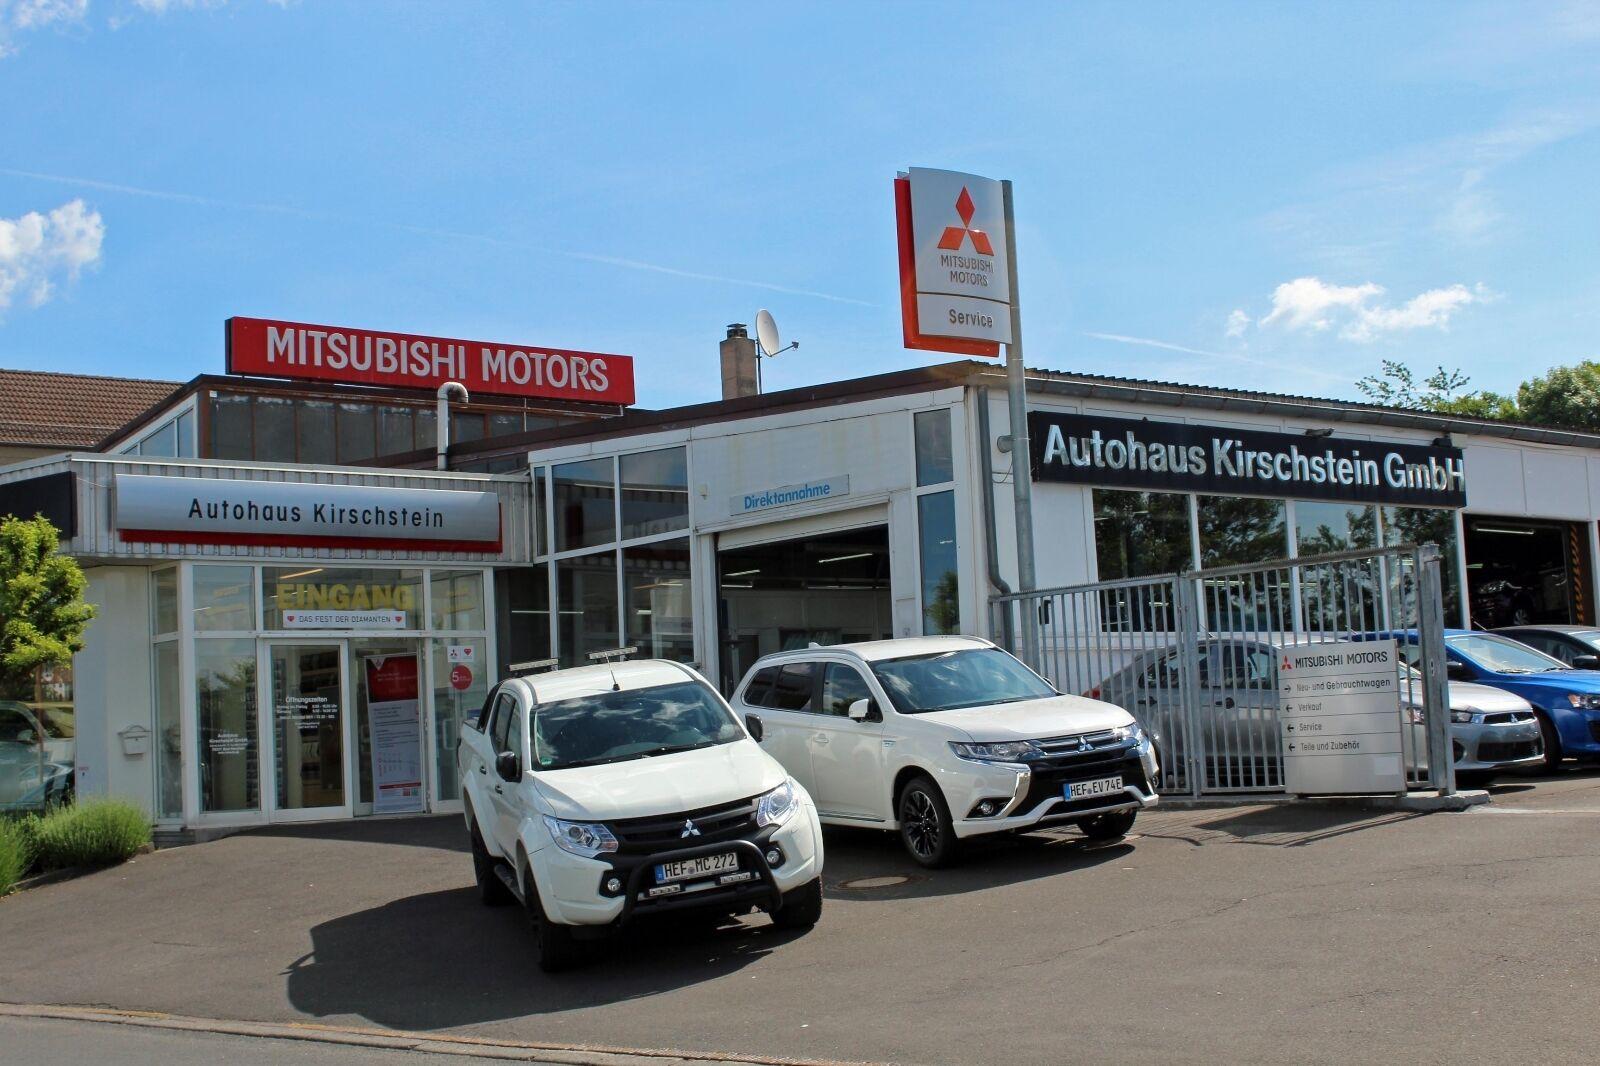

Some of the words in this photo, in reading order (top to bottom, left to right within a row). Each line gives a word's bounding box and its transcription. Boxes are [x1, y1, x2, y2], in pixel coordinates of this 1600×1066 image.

[941, 255, 994, 273] MITSUBISHI
[950, 270, 988, 287] MOTORS
[949, 308, 993, 328] Service
[266, 326, 466, 380] MITSUBISHI
[481, 347, 609, 392] MOTORS
[1043, 424, 1207, 475] Autohaus
[1212, 437, 1380, 487] Kirschstein
[1383, 452, 1466, 492] GmbH
[744, 484, 830, 509] Direktannahme
[188, 498, 301, 522] Autohaus
[313, 503, 443, 527] Kirschstein
[276, 584, 413, 610] EINGANG
[299, 615, 313, 623] DAS
[315, 615, 332, 623] FEST
[335, 615, 349, 623] DER
[351, 615, 391, 623] DIAMANTEN
[1295, 654, 1344, 668] MITSUBISHI
[1347, 651, 1388, 665] MOTORS
[1312, 682, 1325, 690] und
[1326, 678, 1391, 690] Gebrauchtwagen
[1298, 702, 1322, 711] Verkauf
[1299, 722, 1322, 731] Service
[1301, 742, 1315, 751] Teile
[1316, 741, 1329, 750] und
[1330, 740, 1360, 750] Zubehör
[1070, 783, 1087, 797] HEF
[1092, 781, 1104, 793] EV
[1105, 778, 1121, 791] 74E
[664, 861, 687, 878] HEF
[695, 857, 711, 873] MC
[713, 853, 736, 869] 272
